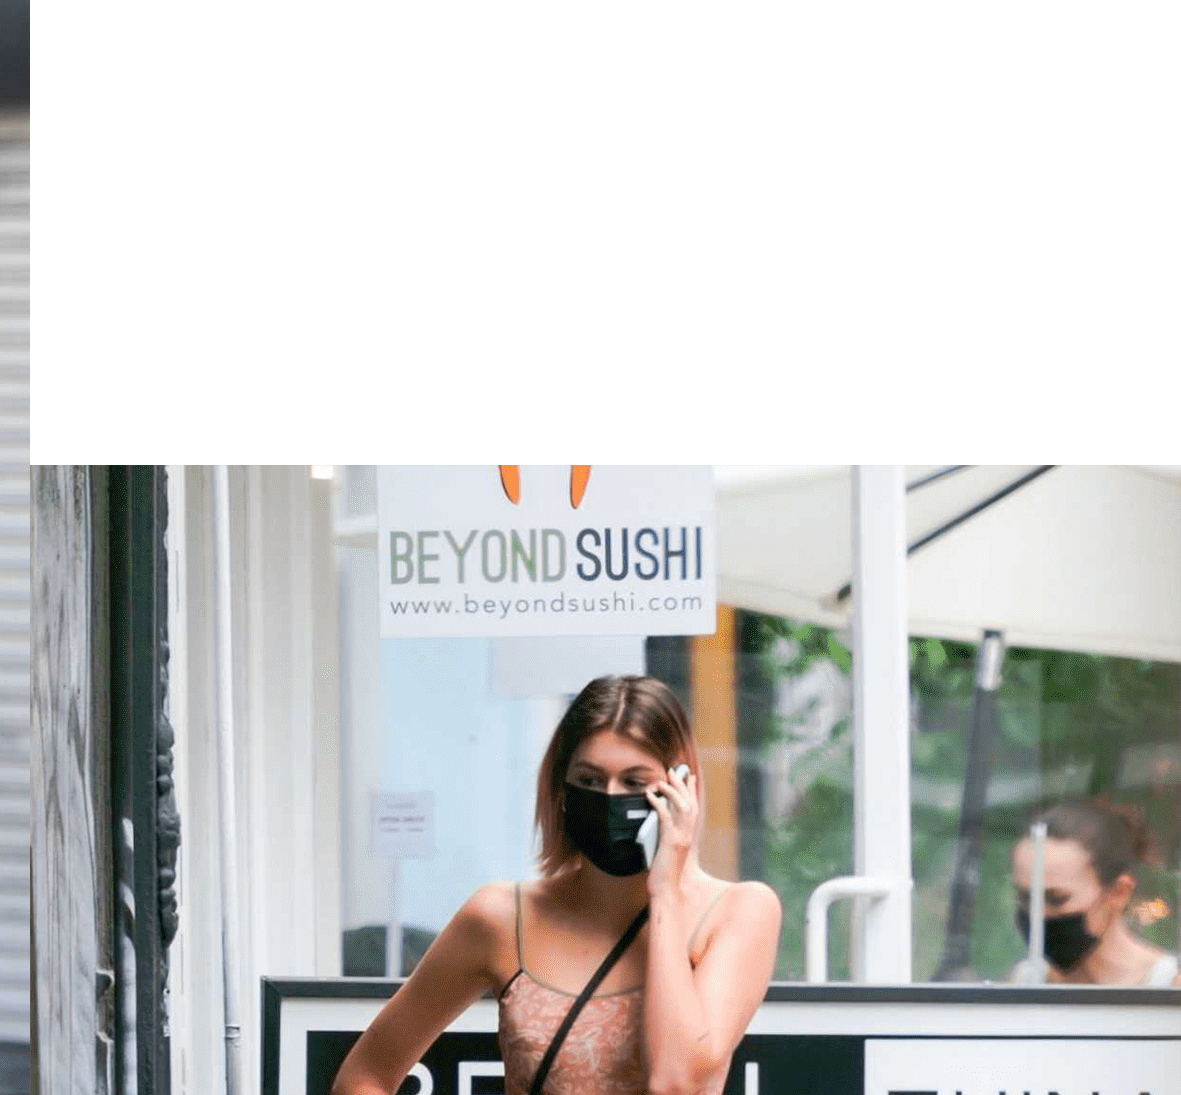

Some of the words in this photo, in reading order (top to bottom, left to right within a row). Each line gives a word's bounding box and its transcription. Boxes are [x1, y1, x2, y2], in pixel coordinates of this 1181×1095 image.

[389, 528, 566, 584] BEYOND
[576, 526, 702, 582] SUSHI
[390, 591, 702, 619] www.beyondsushi.com
